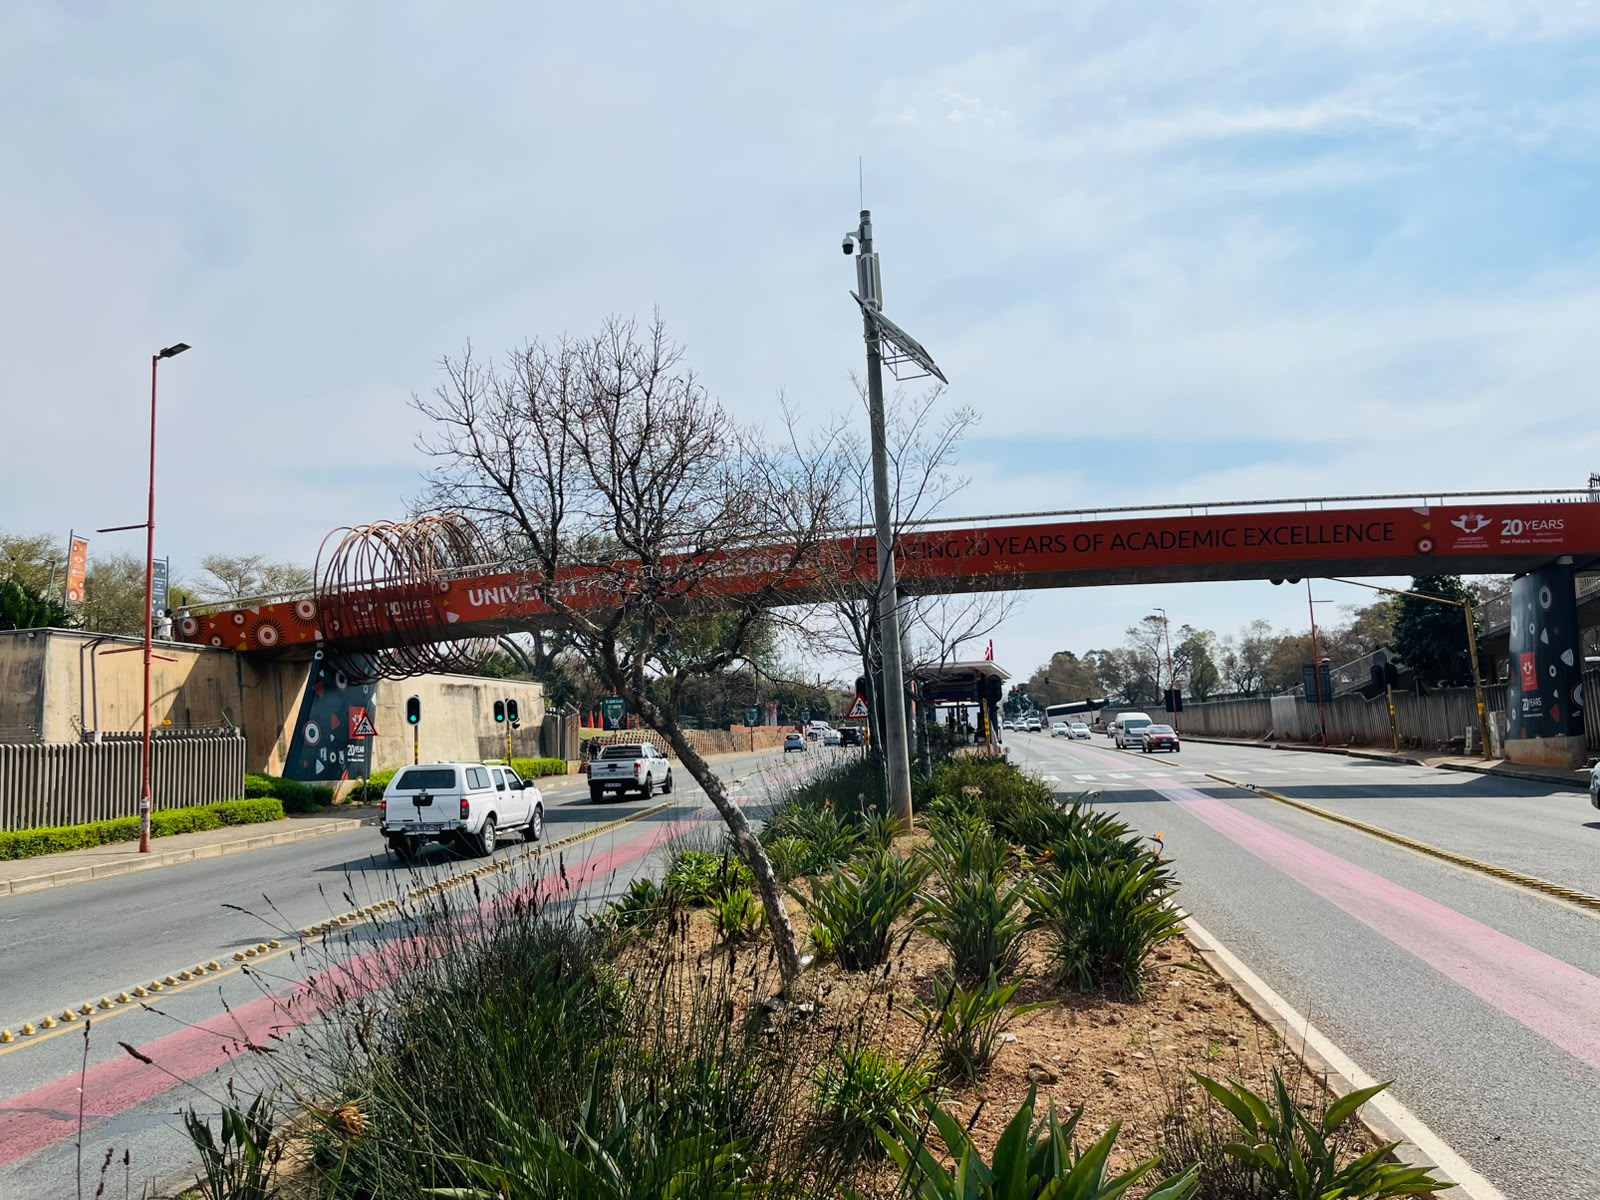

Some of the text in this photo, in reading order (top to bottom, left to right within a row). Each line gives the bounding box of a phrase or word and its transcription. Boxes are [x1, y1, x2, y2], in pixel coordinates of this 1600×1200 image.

[964, 538, 990, 556] 20
[994, 535, 1067, 555] YEARS
[1073, 534, 1104, 553] OF
[1110, 528, 1237, 551] ACADEMIC
[1244, 522, 1395, 546] EXCELLENCE
[1501, 519, 1564, 536] 20 YEARS
